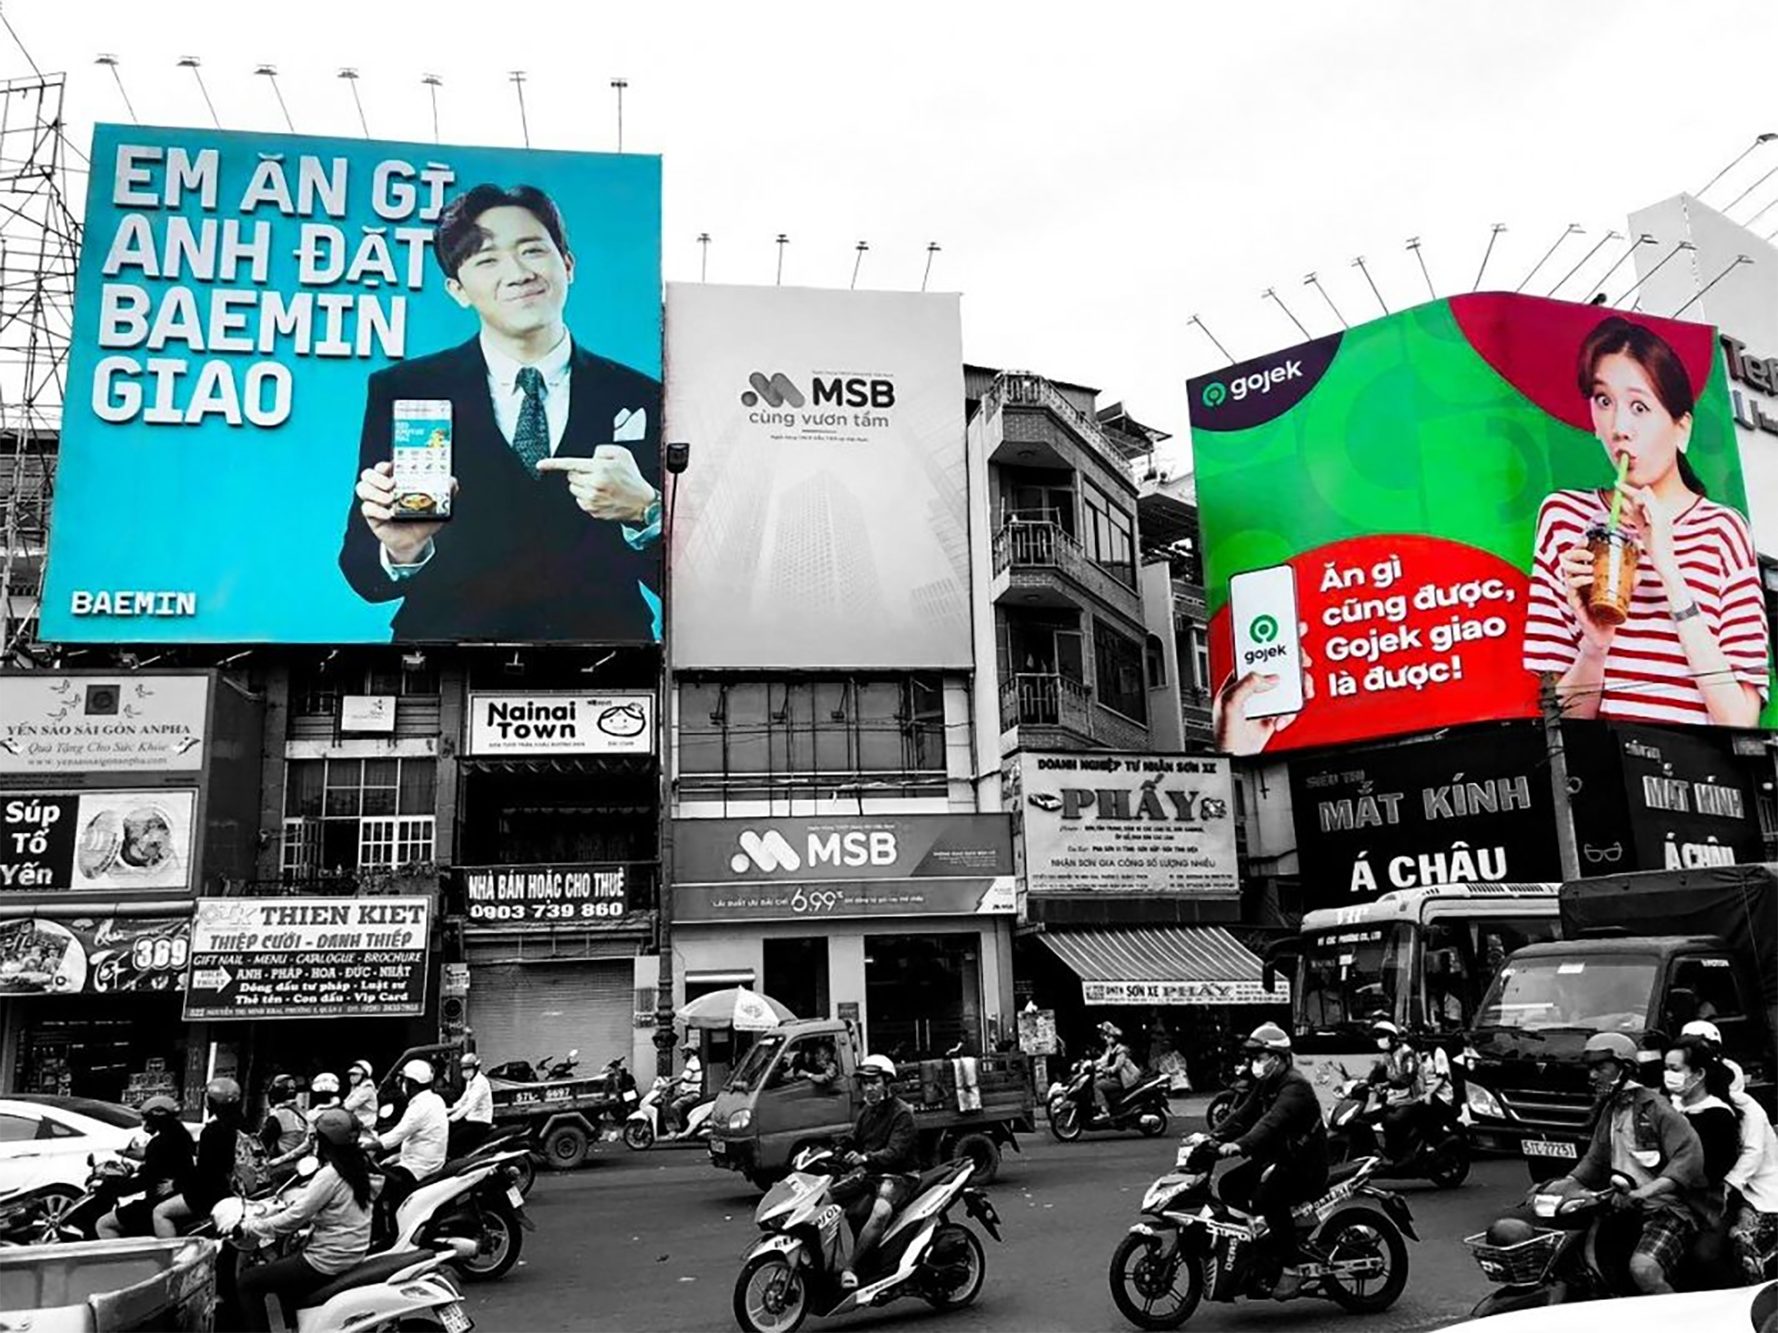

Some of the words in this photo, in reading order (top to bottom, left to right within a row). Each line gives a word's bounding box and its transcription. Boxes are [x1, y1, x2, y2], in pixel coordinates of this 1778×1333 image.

[114, 144, 219, 209] EM
[240, 152, 348, 217] ĂN
[372, 161, 455, 220] GÌ
[102, 213, 271, 283] ANH
[292, 225, 436, 289] ĐẶT
[98, 283, 407, 358] BAEMIN
[92, 356, 293, 427] GIAO
[812, 377, 896, 408] MSB
[1231, 360, 1303, 401] gojek
[750, 409, 796, 427] cùng
[802, 411, 847, 427] vươn
[1320, 562, 1366, 593] Ăn
[1371, 555, 1402, 588] gì
[71, 590, 197, 616] BAEMIN
[1322, 598, 1407, 627] cũng
[1414, 577, 1516, 609] được,
[1326, 625, 1423, 662] Gojek
[1429, 614, 1508, 651] giao
[1244, 642, 1287, 665] gojek
[1329, 671, 1357, 697] là
[1364, 654, 1463, 691] được!
[7, 721, 37, 736] YẾN
[41, 722, 71, 736] SÀO
[74, 721, 99, 735] SÀI
[103, 721, 137, 735] GÒN
[140, 724, 191, 735] ANPHA
[487, 701, 576, 727] Nainai
[496, 722, 576, 740] Town
[1038, 759, 1077, 771] DOANH
[1080, 757, 1122, 773] NGHIỆP
[1124, 760, 1141, 773] TƯ
[1176, 762, 1200, 774] SƠN
[1202, 763, 1217, 774] XE
[1060, 773, 1200, 821] PHẤY
[1318, 780, 1404, 833] MẮT
[1422, 772, 1532, 820] KÍNH
[5, 799, 61, 828] Súp
[808, 831, 897, 867] MSB
[0, 861, 53, 886] Yến
[1350, 851, 1378, 892] Á
[1387, 841, 1508, 889] CHÂU
[469, 869, 495, 900] NHÀ
[498, 868, 525, 900] BÁN
[528, 868, 562, 905] HOẶC
[565, 872, 591, 899] CHO
[594, 866, 625, 898] THUÊ
[260, 905, 351, 925] THIEN
[357, 904, 425, 925] KIET
[470, 903, 526, 919] 0903
[532, 903, 575, 919] 739
[581, 902, 624, 918] 860
[135, 936, 189, 970] 369
[210, 932, 259, 952] THIỆP
[317, 933, 362, 949] DANH
[366, 928, 413, 948] THIẾP
[193, 954, 218, 966] GIFT
[219, 954, 244, 966] NAIL
[253, 954, 288, 965] MENU
[296, 952, 356, 965] CATALOGUE
[363, 951, 423, 963] BROCHURE
[236, 968, 263, 980] ANH
[270, 965, 303, 980] PHÁP
[311, 966, 337, 979] HOA
[293, 992, 318, 1005] Con
[378, 991, 409, 1002] Card
[1126, 984, 1145, 998] SƠN
